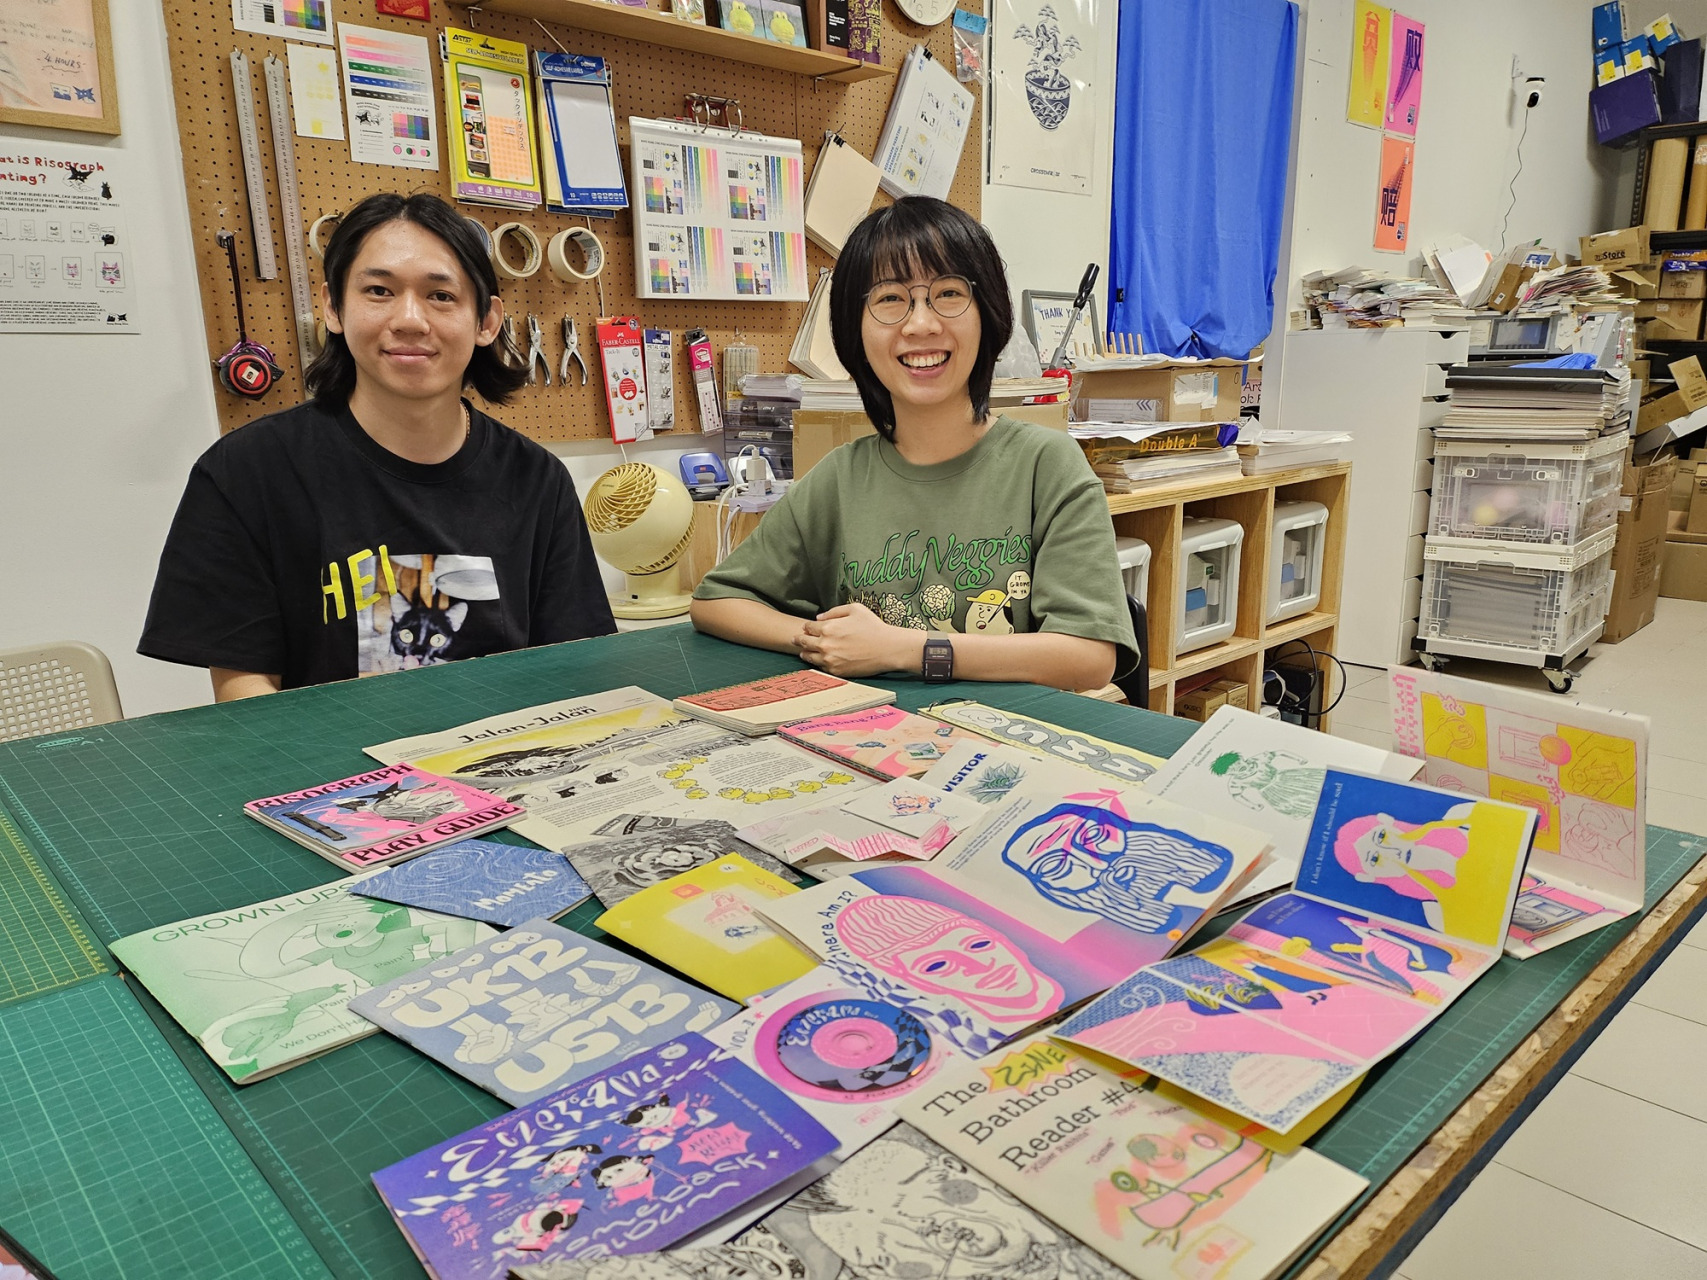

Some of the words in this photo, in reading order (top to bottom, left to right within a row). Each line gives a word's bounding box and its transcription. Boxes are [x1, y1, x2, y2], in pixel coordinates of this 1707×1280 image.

[916, 3, 923, 19] 6
[55, 57, 81, 69] HOURS
[0, 172, 47, 186] nting?
[34, 156, 105, 172] Risograph
[1603, 250, 1625, 260] Store
[1040, 307, 1063, 320] THANK
[1140, 435, 1184, 453] Double
[1188, 435, 1198, 448] A
[926, 526, 1032, 591] Veggies
[458, 706, 597, 744] Jalan-Jalan
[251, 762, 416, 811] RISOGRAPH
[942, 753, 988, 792] VISITOR
[349, 834, 429, 862] PLAY
[436, 802, 520, 837] GUIDE
[152, 882, 358, 943] GROWN-UPS
[391, 939, 588, 1028] UK12
[279, 1036, 304, 1050] We
[305, 1025, 345, 1042] Don't
[494, 984, 691, 1093] US13
[923, 1077, 988, 1118] The
[959, 1065, 1098, 1145] Bathroom
[998, 1105, 1105, 1171] Reader
[1101, 1080, 1144, 1107] #4
